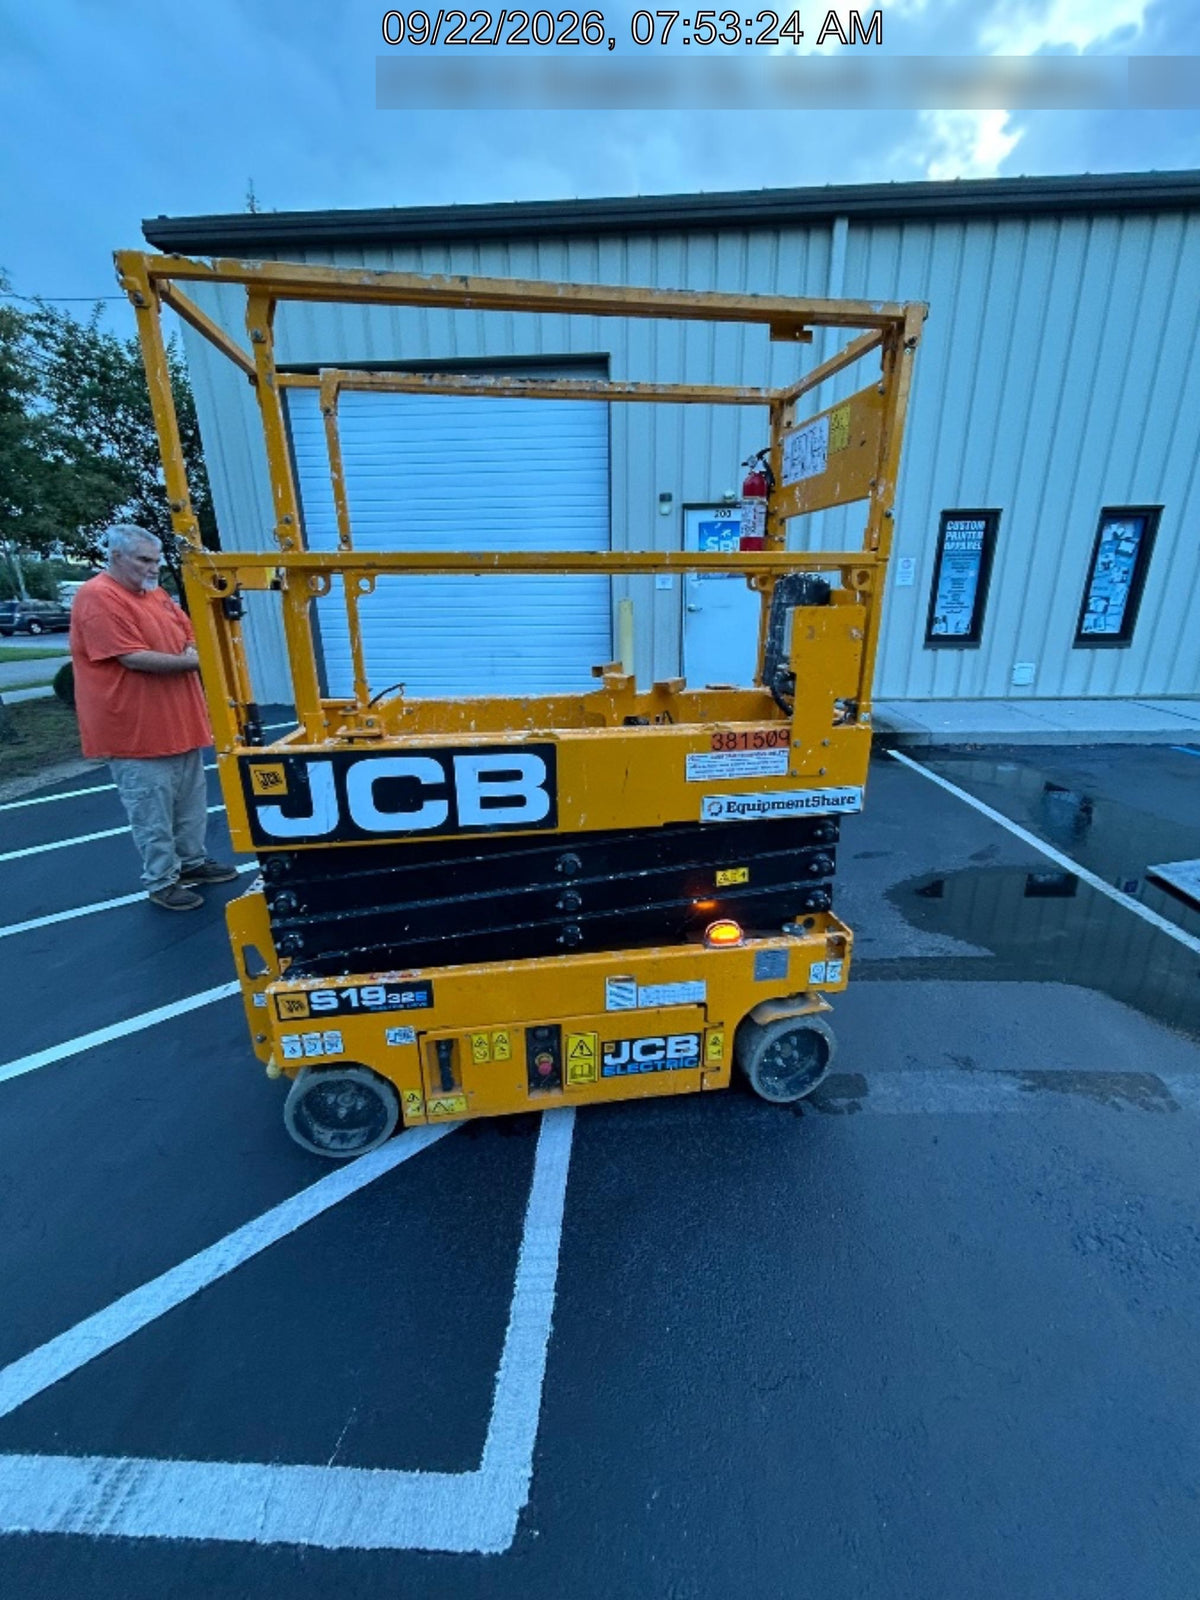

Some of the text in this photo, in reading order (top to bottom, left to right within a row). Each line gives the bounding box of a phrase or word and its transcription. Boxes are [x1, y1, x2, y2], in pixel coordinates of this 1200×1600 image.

[946, 520, 986, 530] CUSTOM
[711, 728, 790, 750] 381509
[255, 753, 550, 838] JCB
[726, 793, 857, 816] EquipmentShare
[603, 1034, 700, 1066] JCB
[602, 1057, 699, 1077] ELECTRIC
